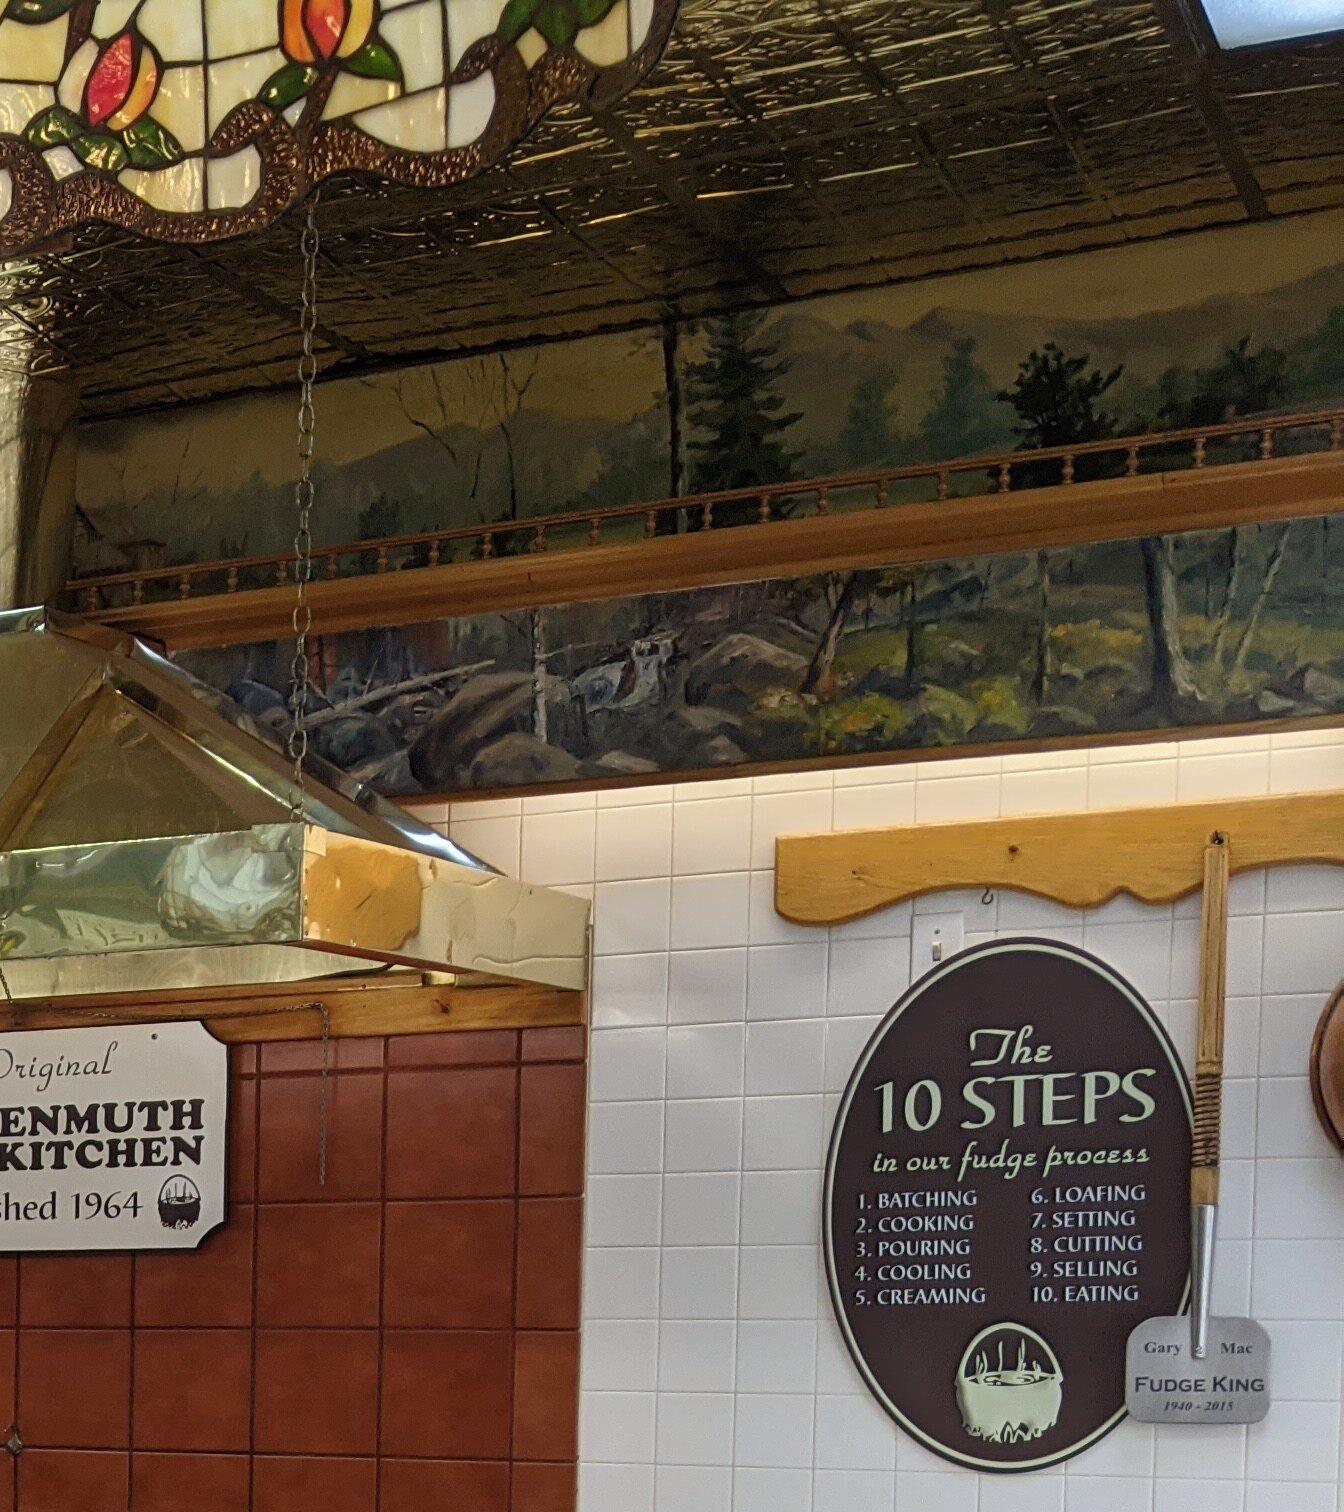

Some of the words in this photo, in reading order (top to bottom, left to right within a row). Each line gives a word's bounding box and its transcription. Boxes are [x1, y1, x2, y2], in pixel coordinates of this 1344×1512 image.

[969, 1024, 1053, 1067] The
[873, 1079, 942, 1134] 10
[960, 1068, 1157, 1130] STEPS
[873, 1152, 898, 1173] in
[905, 1154, 951, 1172] our
[957, 1138, 1039, 1182] fudge
[1041, 1144, 1151, 1179] process
[859, 1194, 872, 1210] 1.
[877, 1189, 978, 1210] BATCHING
[1031, 1187, 1049, 1204] 6.
[1055, 1184, 1147, 1203] LOAFING
[70, 1190, 144, 1221] 1964
[855, 1218, 873, 1234] 2.
[877, 1214, 975, 1233] COOKING
[1031, 1212, 1046, 1229] 7.
[1052, 1209, 1137, 1228] SETTING
[855, 1242, 873, 1258] 3.
[877, 1239, 971, 1258] POURING
[1030, 1237, 1048, 1253] 8.
[1053, 1235, 1143, 1253] CUTTING
[854, 1266, 872, 1282] 4.
[877, 1264, 972, 1281] COOLING
[1030, 1261, 1048, 1278] 9.
[1053, 1259, 1138, 1277] SELLING
[855, 1290, 872, 1306] 5.
[877, 1287, 987, 1306] CREAMING
[1032, 1286, 1058, 1303] 10.
[1064, 1284, 1139, 1302] EATING
[1144, 1341, 1183, 1356] Gary
[1220, 1342, 1254, 1354] Mac
[1135, 1376, 1206, 1393] FUDGE
[1212, 1375, 1265, 1393] KING
[1164, 1401, 1193, 1411] 1940
[1203, 1401, 1234, 1411] 2015
